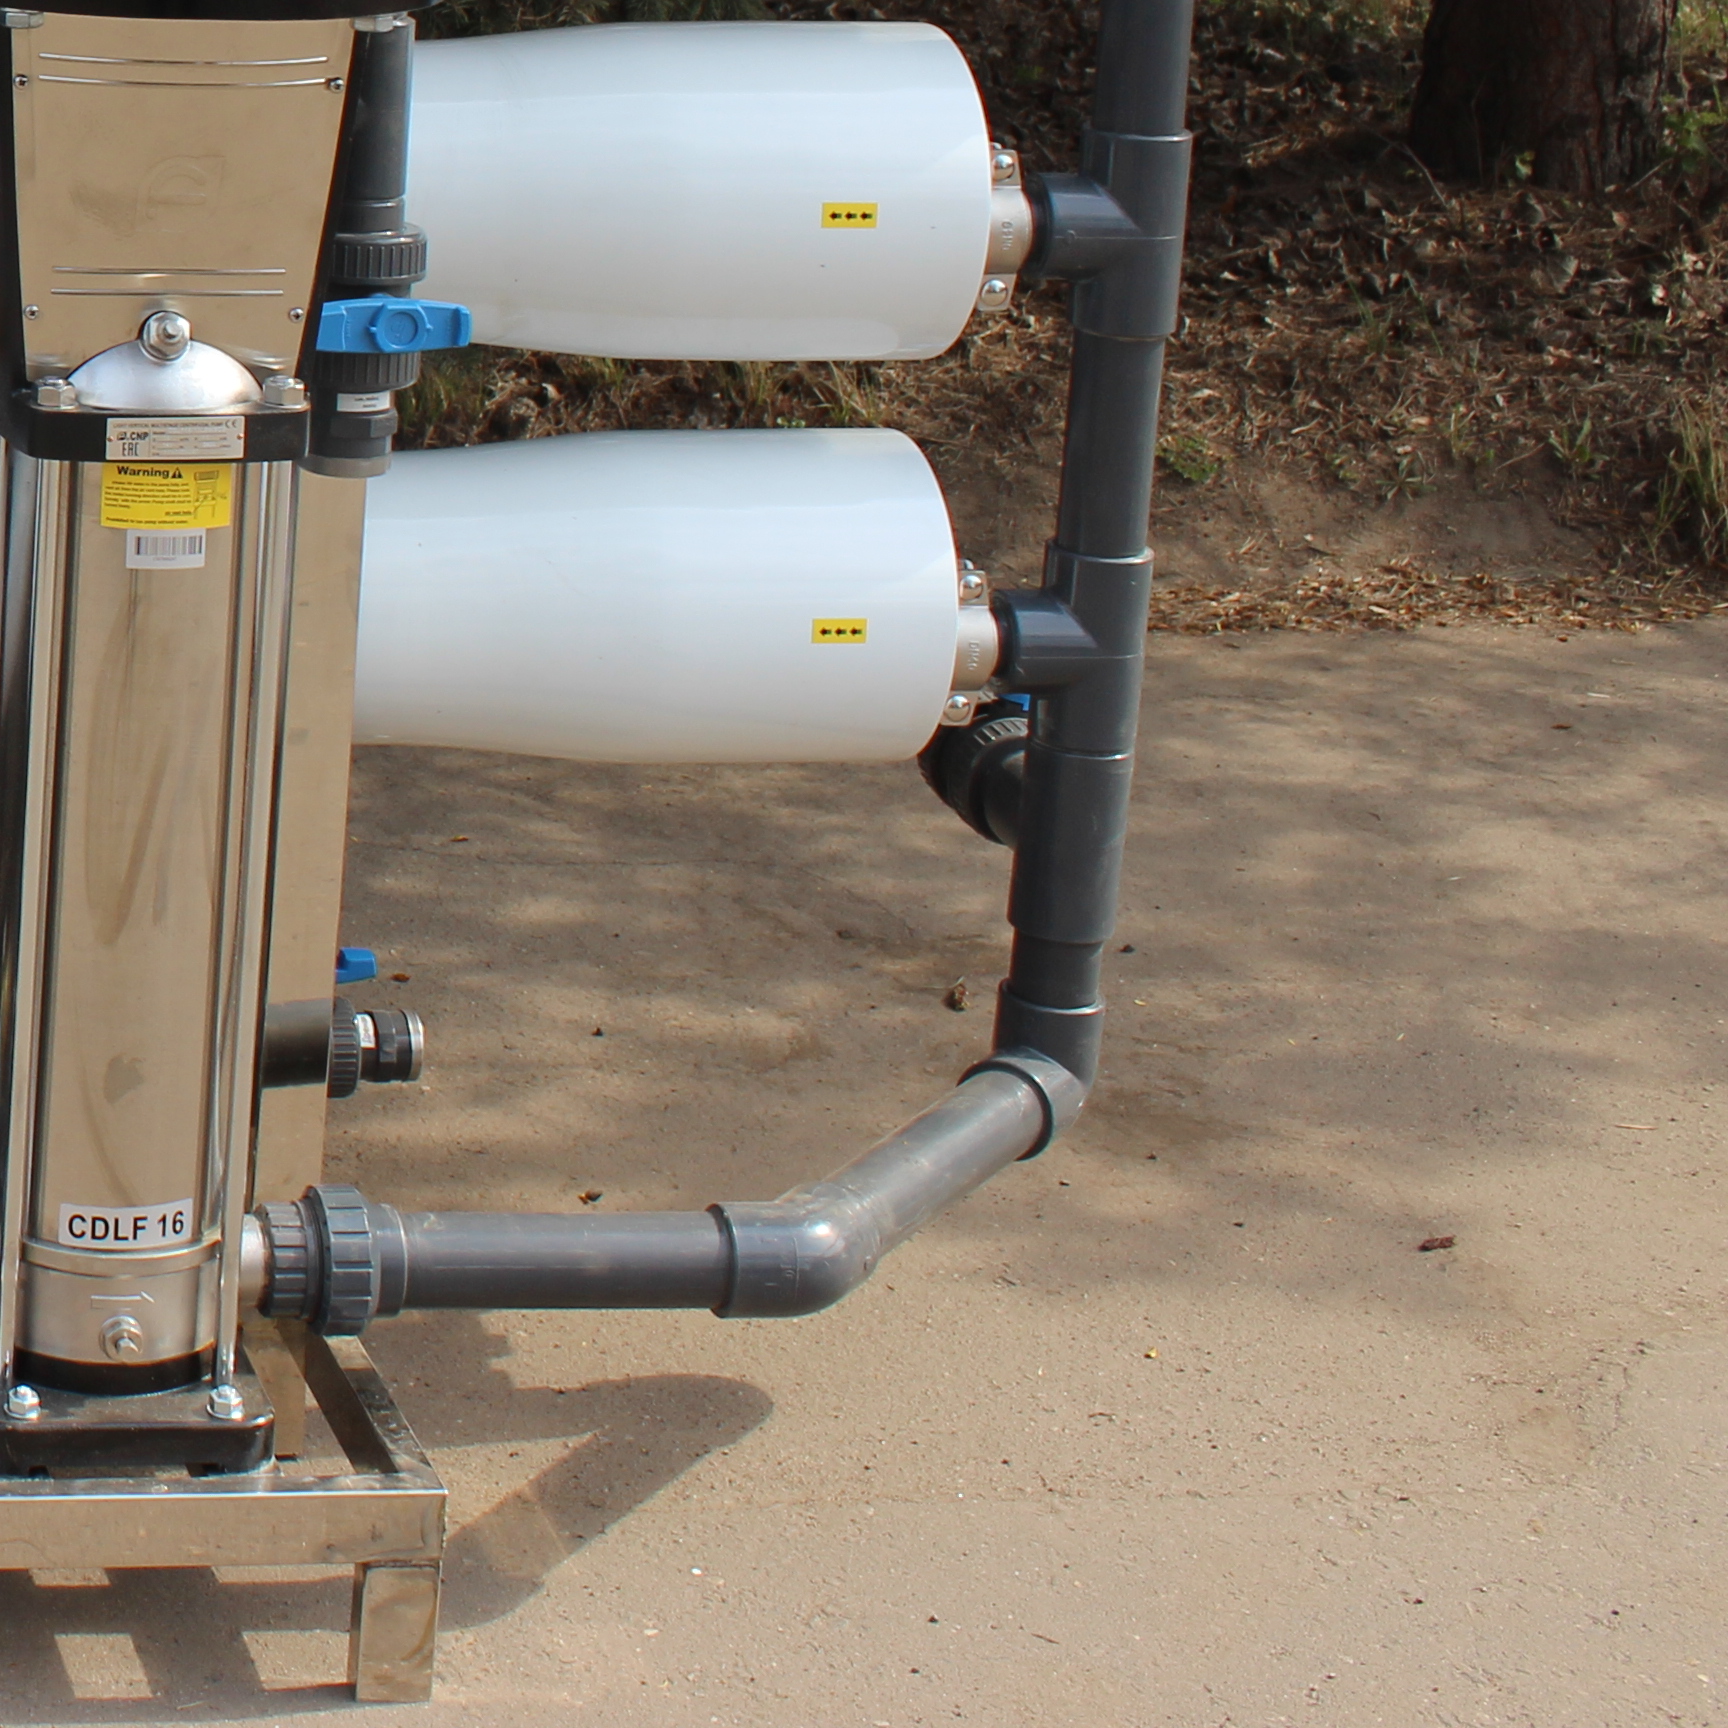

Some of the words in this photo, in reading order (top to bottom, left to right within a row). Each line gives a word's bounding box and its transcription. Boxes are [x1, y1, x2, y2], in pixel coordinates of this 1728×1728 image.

[130, 432, 149, 440] CNP
[117, 465, 169, 478] Warning
[67, 1213, 151, 1241] CDLF
[155, 1210, 185, 1239] 16
